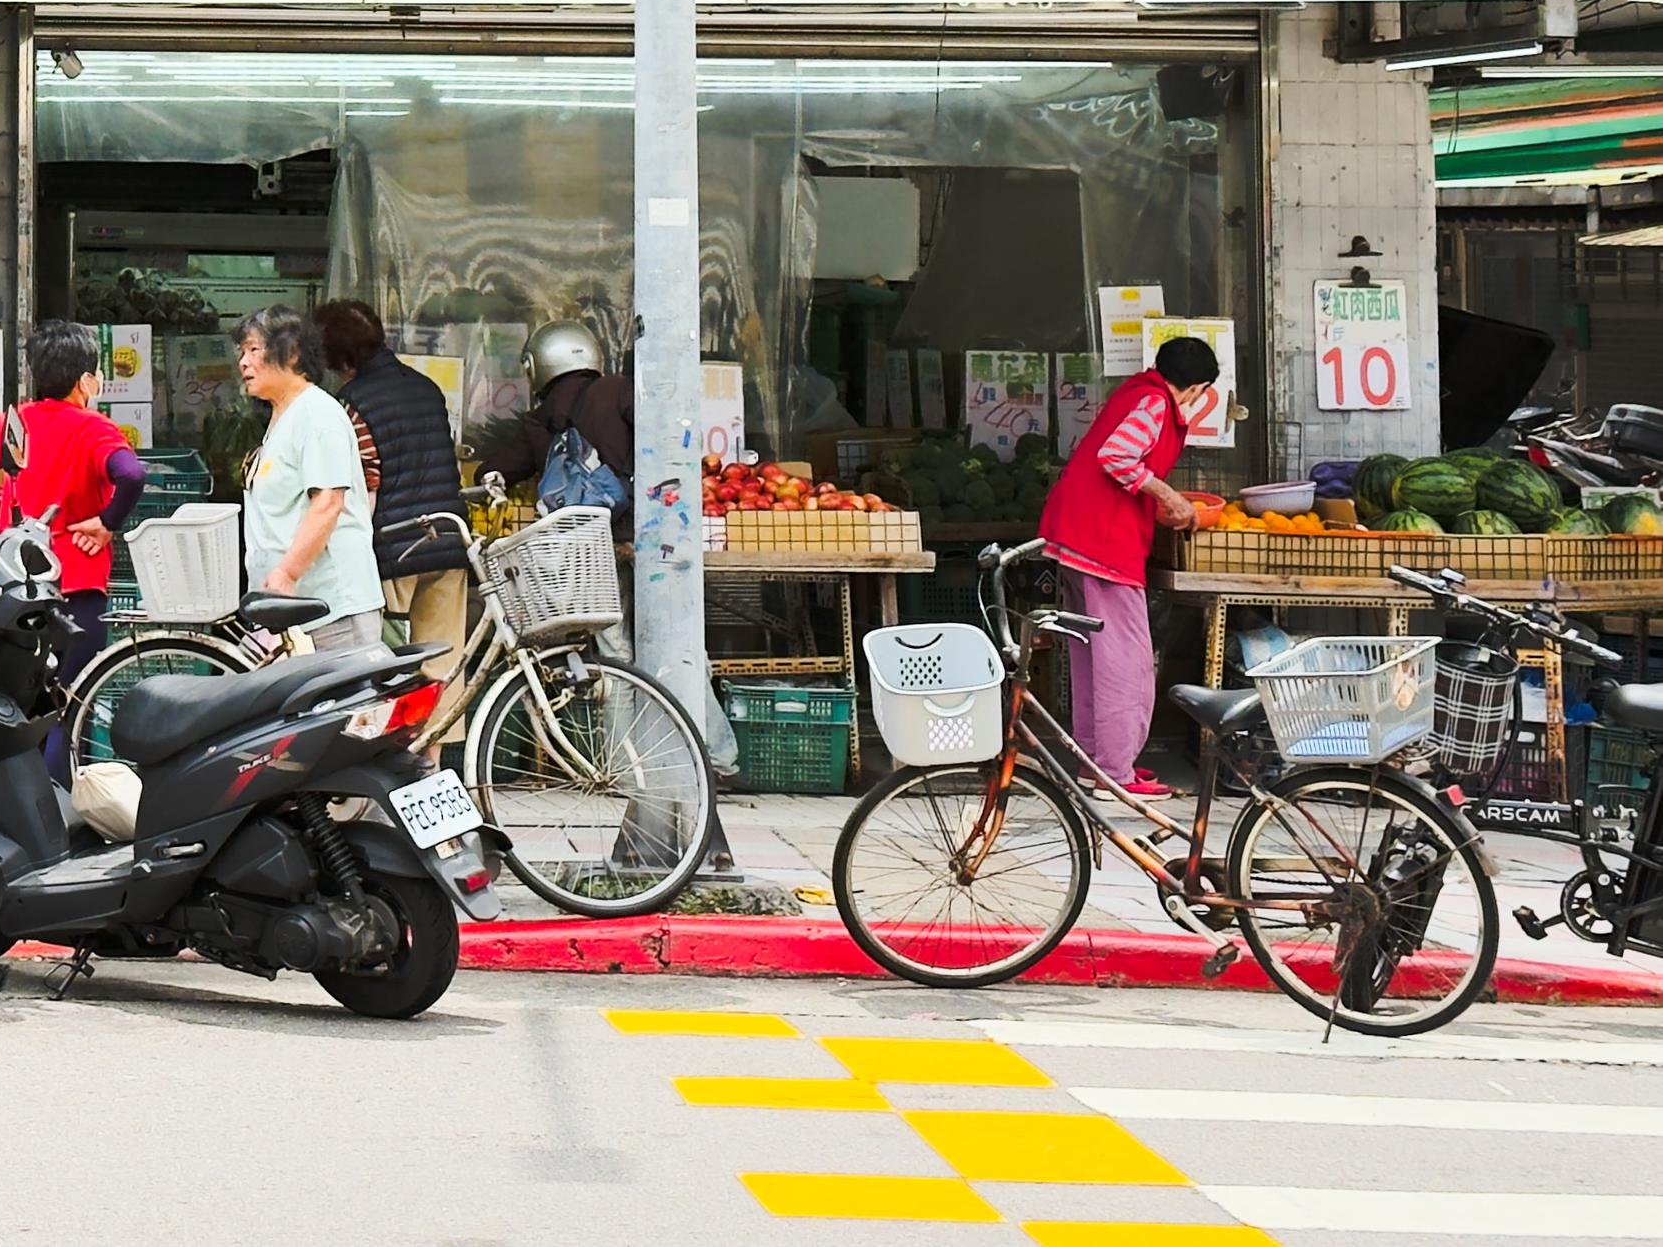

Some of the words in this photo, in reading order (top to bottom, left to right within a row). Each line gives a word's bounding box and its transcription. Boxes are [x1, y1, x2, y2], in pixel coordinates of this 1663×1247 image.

[1333, 288, 1401, 321] 紅肉西瓜
[1322, 346, 1397, 406] 10
